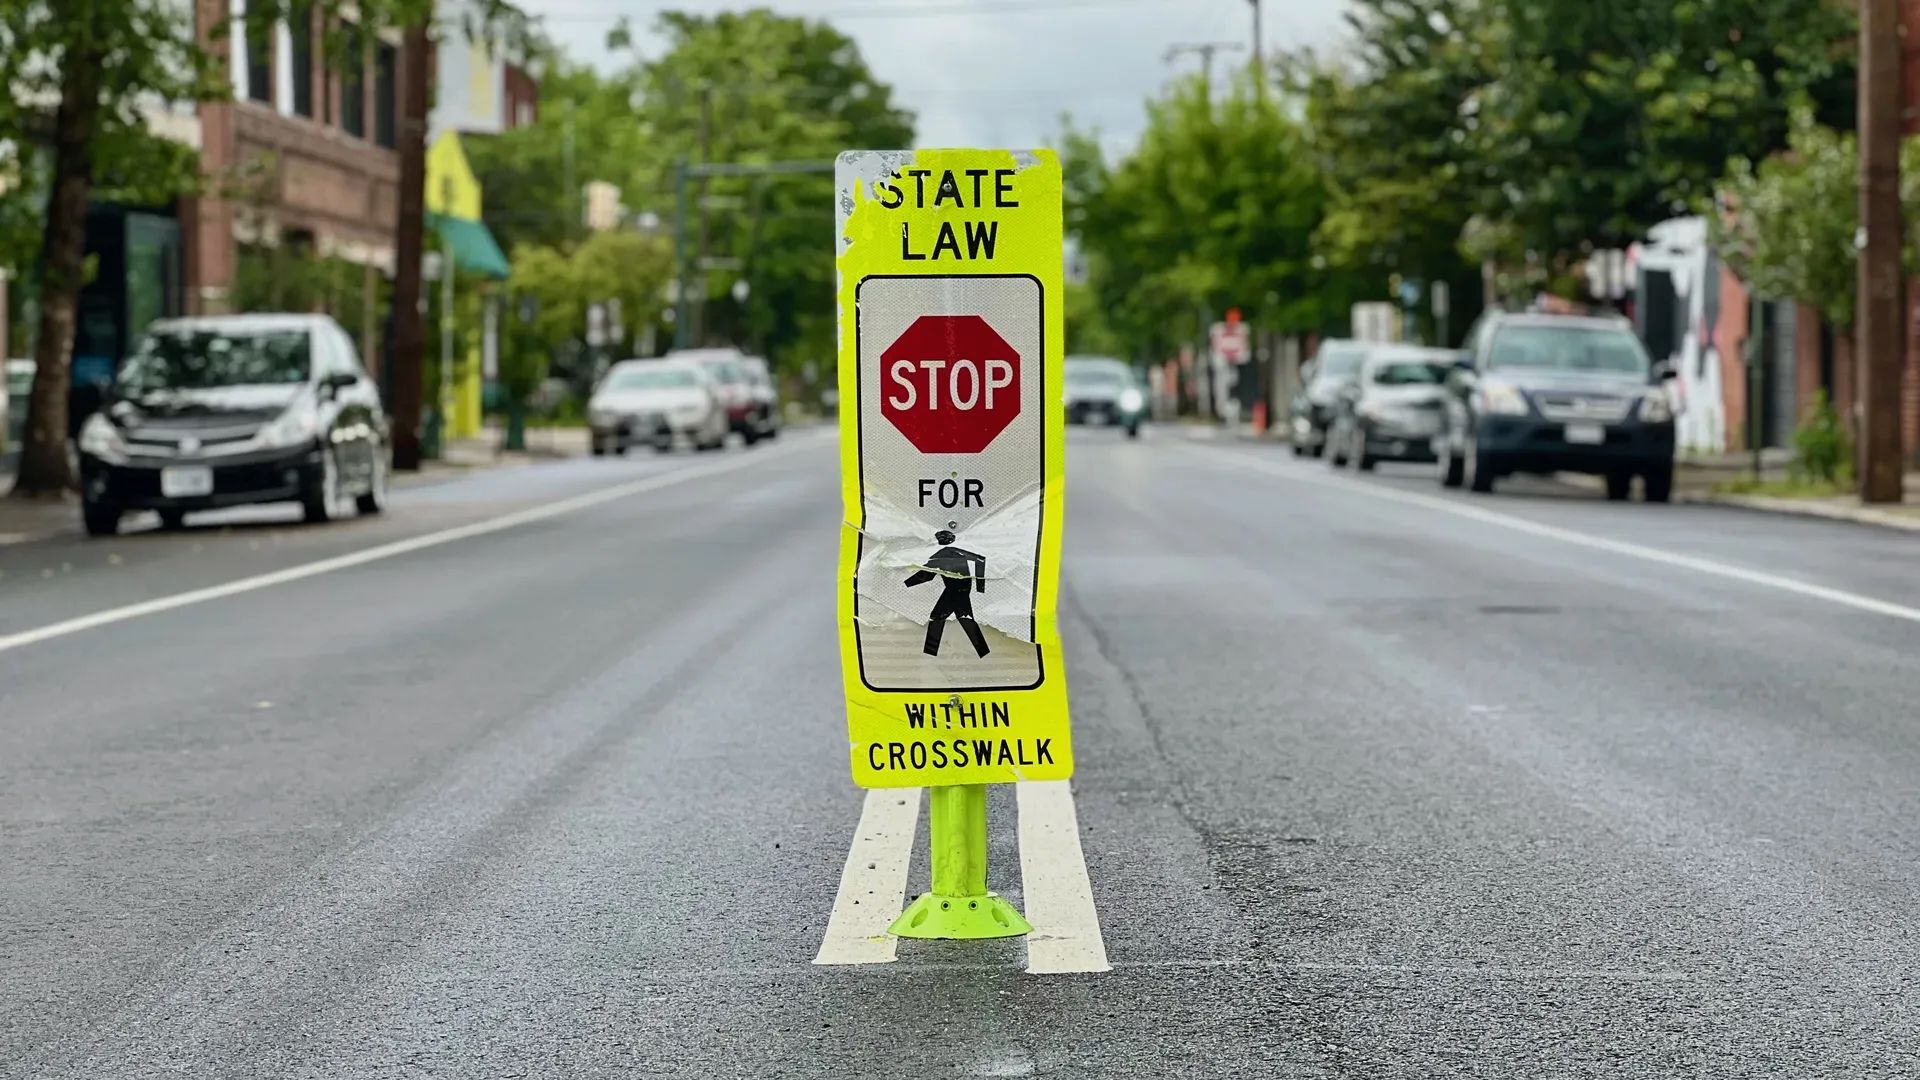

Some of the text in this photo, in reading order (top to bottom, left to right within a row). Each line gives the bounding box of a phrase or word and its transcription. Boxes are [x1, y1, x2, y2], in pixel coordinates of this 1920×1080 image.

[879, 169, 1020, 210] STATE
[902, 221, 998, 261] LAW
[888, 359, 1014, 411] STOP
[918, 478, 984, 509] FOR
[904, 701, 1010, 730] WITHIN
[868, 738, 1054, 771] CROSSWALK
